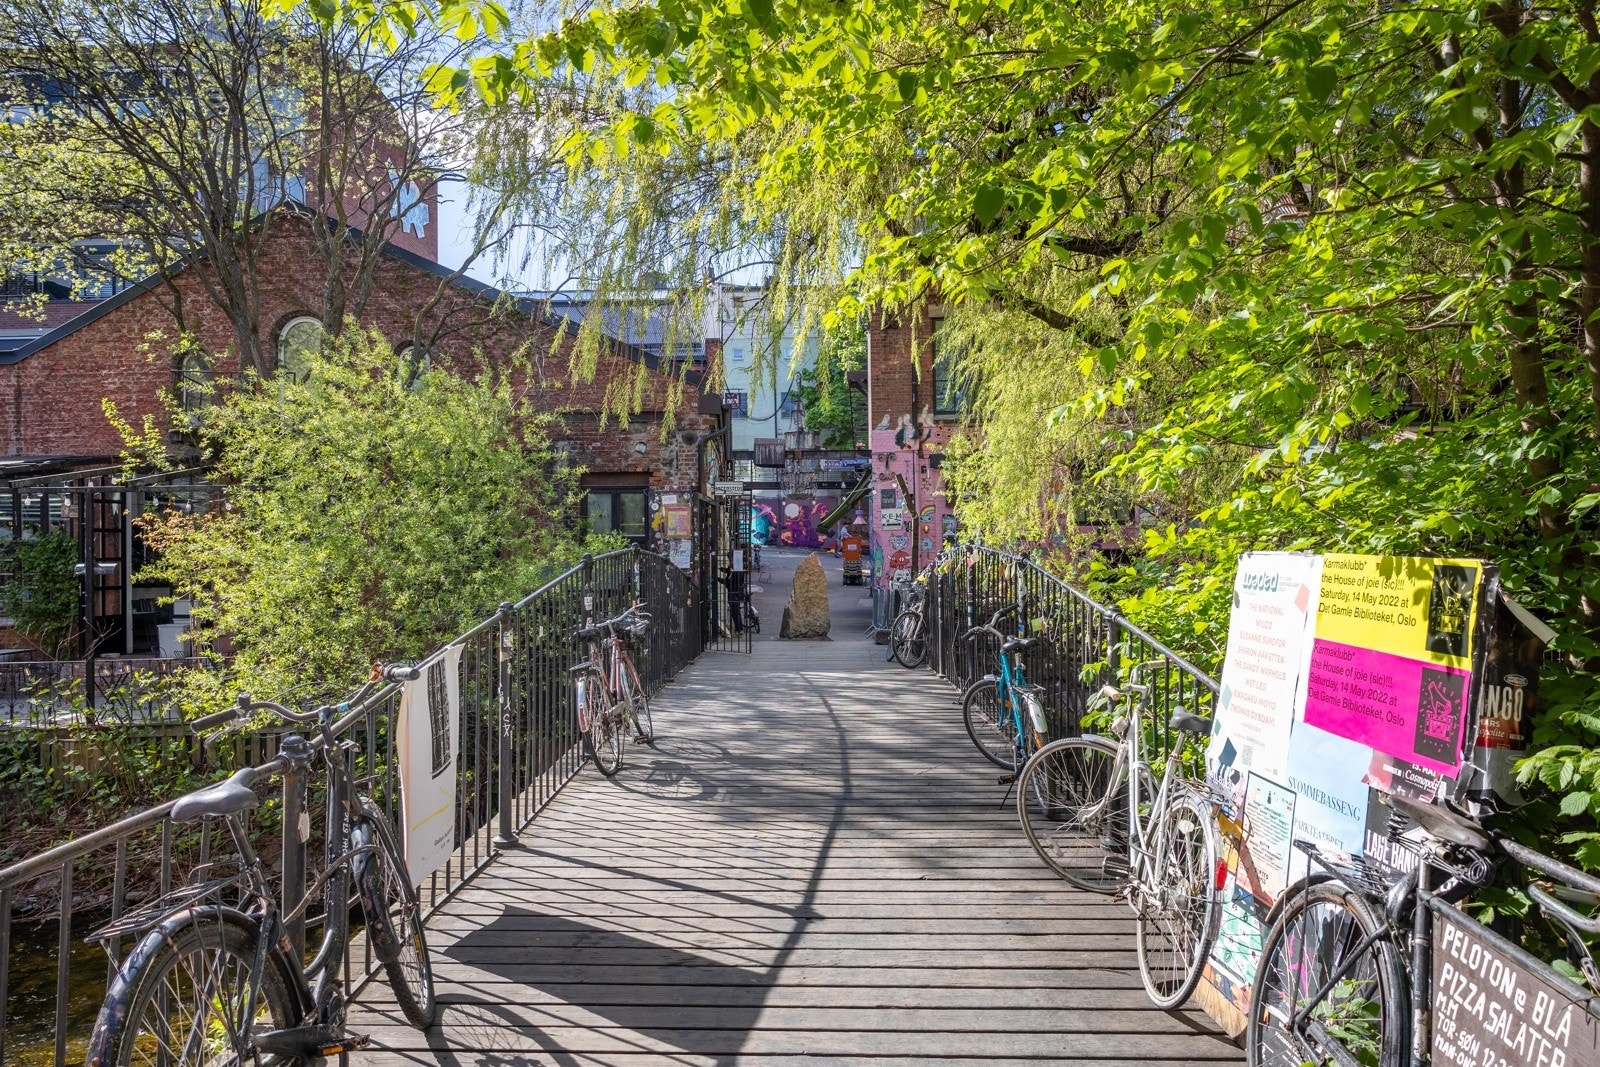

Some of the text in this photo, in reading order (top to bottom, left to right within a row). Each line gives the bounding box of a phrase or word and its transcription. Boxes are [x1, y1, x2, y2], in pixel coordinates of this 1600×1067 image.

[1322, 573, 1332, 582] the
[1334, 574, 1355, 586] House
[1356, 578, 1364, 586] of
[1365, 577, 1379, 589] joie
[1320, 588, 1409, 608] Saturday, 14 May 2022 at
[1258, 604, 1284, 616] NATIONAL
[1318, 602, 1416, 626] Det Gamle Biblioteket, Oslo
[1260, 666, 1286, 681] WARHOLS
[1312, 658, 1392, 688] the House of joie (sic)!!!
[1310, 672, 1398, 706] Saturday, 14 May 2022 at
[1258, 698, 1276, 710] MOYO
[1308, 687, 1404, 726] Det Gamle Biblioteket, Oslo
[1480, 728, 1505, 738] opolite
[1442, 923, 1516, 999] PELOTON
[1532, 990, 1573, 1047] BLÅ
